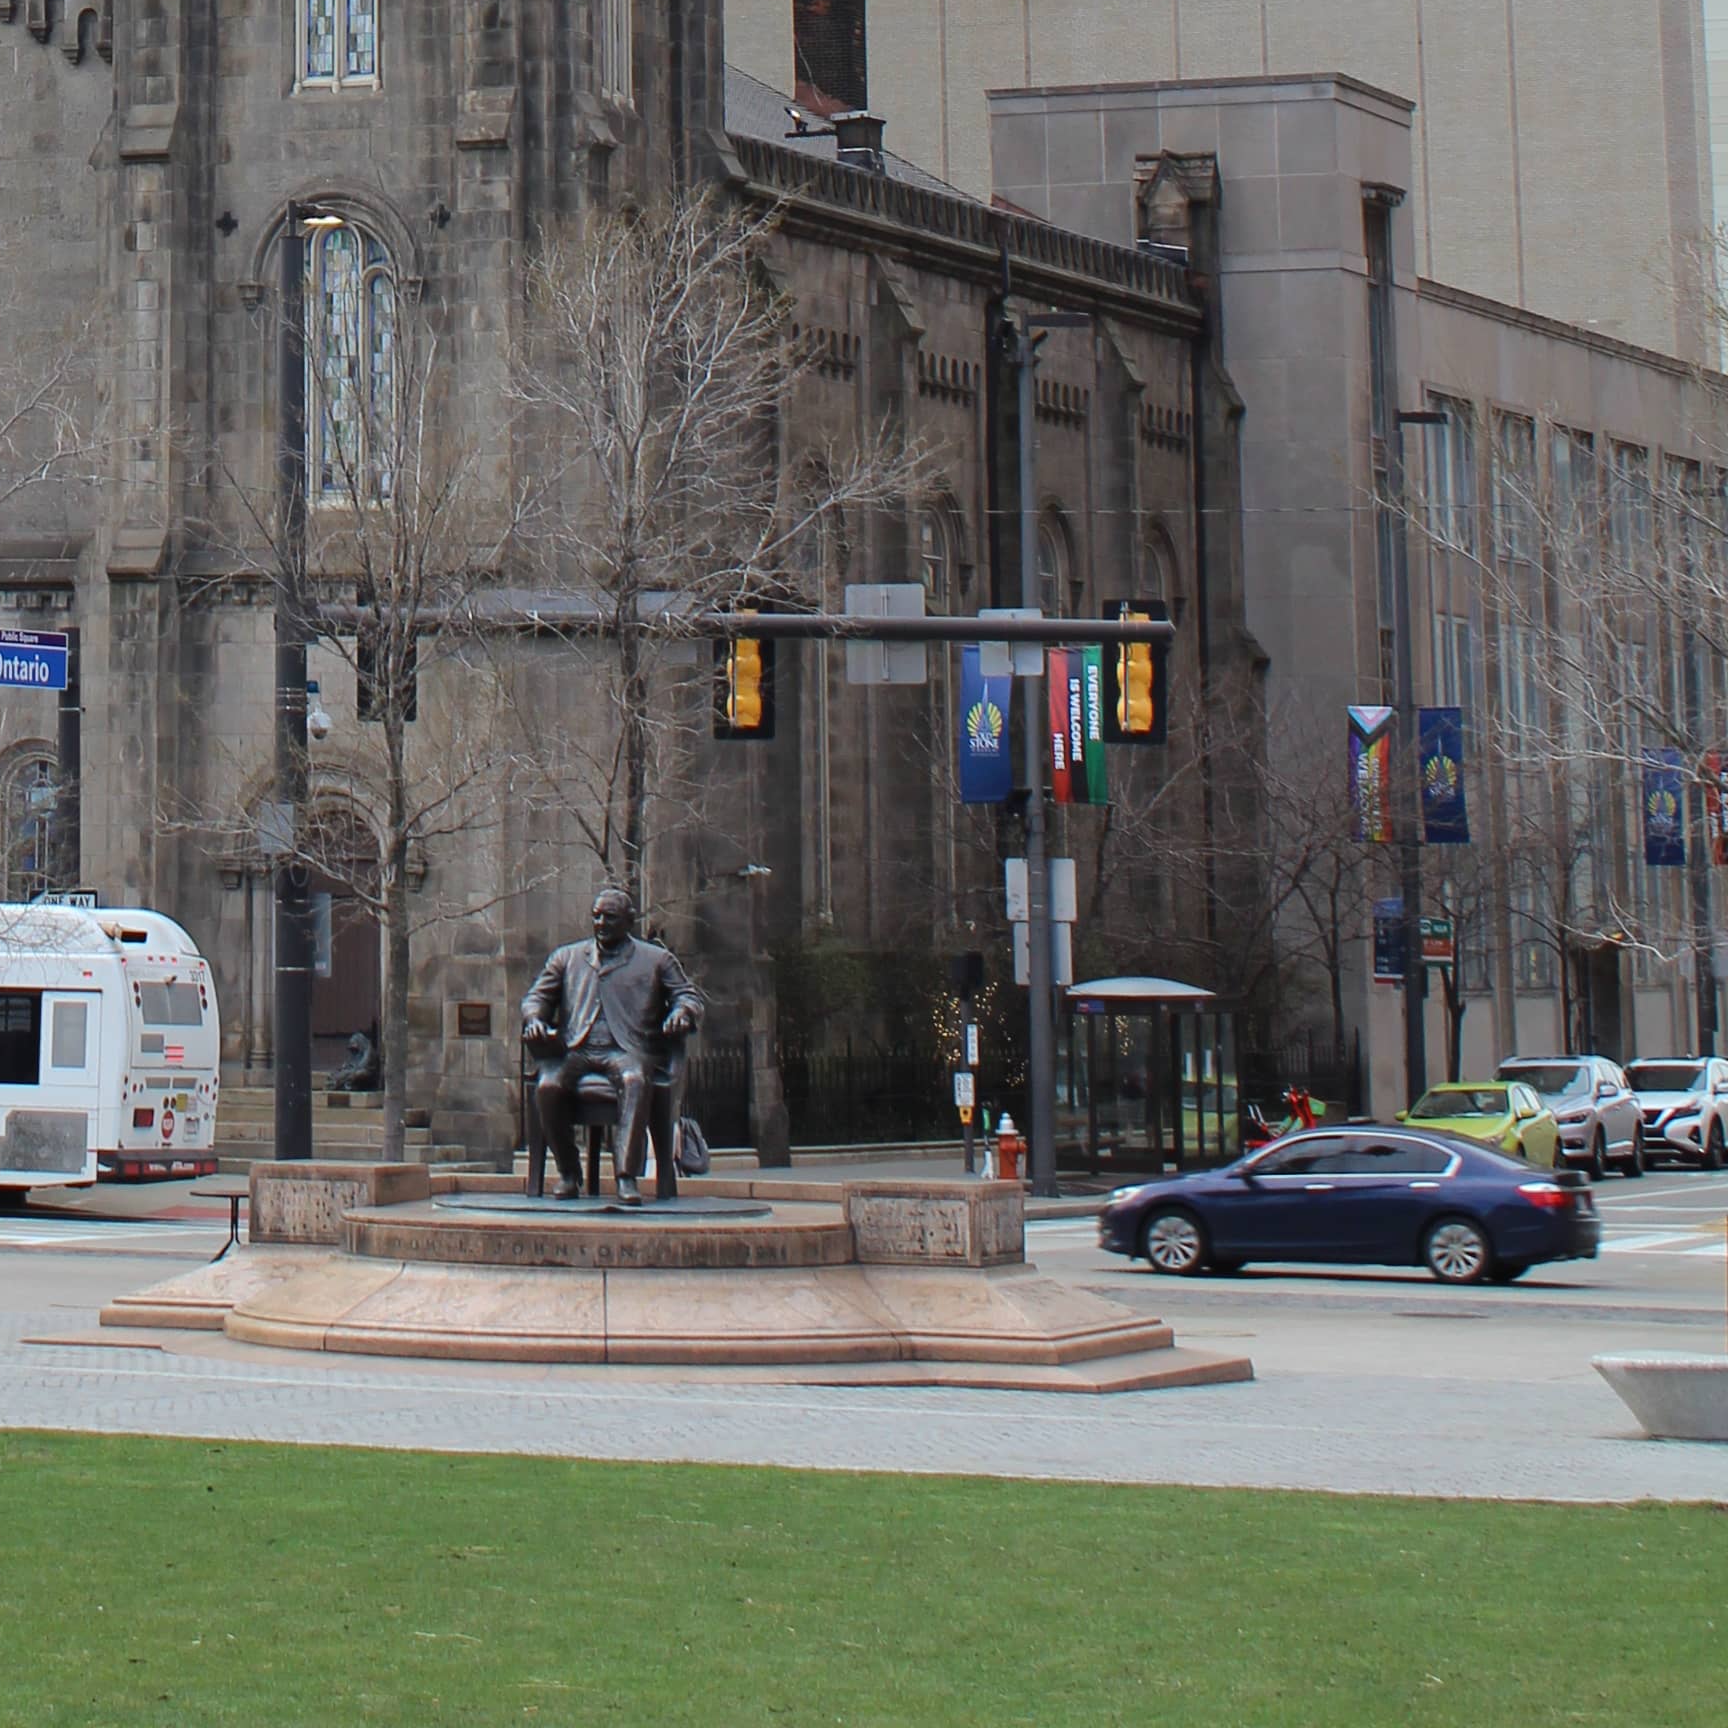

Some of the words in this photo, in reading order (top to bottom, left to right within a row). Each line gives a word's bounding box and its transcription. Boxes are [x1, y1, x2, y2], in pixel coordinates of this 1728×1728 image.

[1, 631, 18, 642] Public
[19, 632, 39, 644] Square
[1069, 679, 1080, 691] IS
[1087, 665, 1100, 741] EVERYONE
[1070, 691, 1083, 762] WELCOME
[1053, 732, 1065, 770] HERE
[69, 895, 90, 907] WAY
